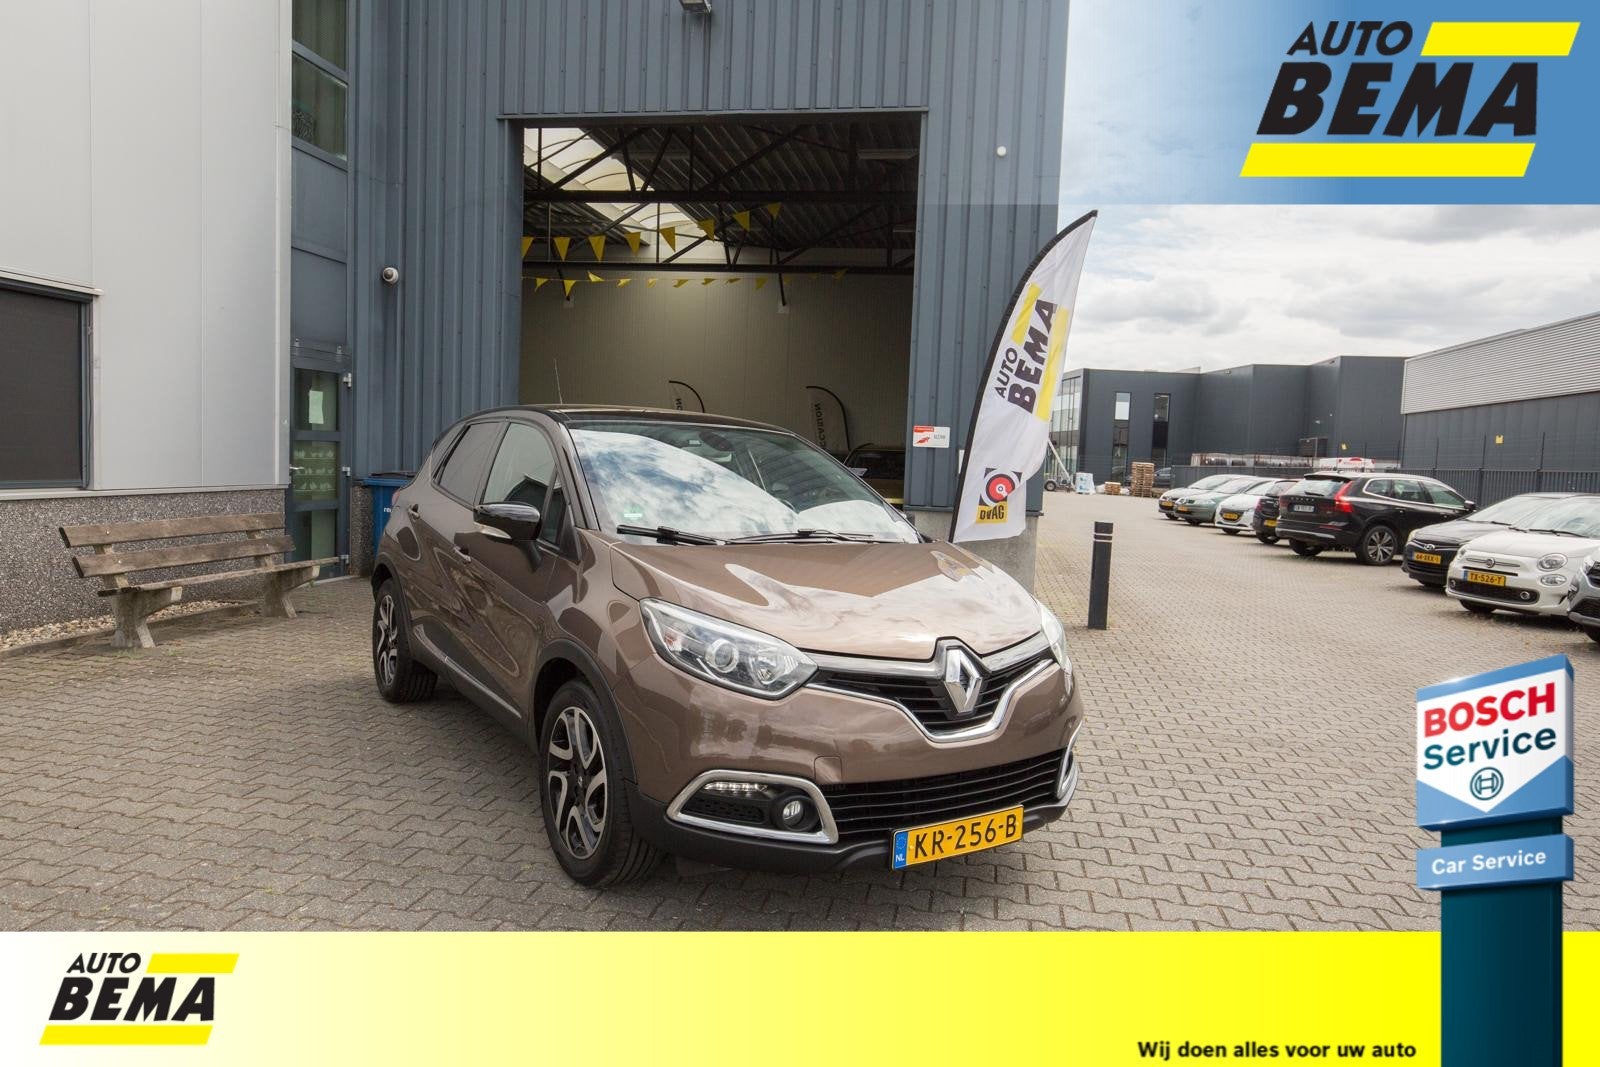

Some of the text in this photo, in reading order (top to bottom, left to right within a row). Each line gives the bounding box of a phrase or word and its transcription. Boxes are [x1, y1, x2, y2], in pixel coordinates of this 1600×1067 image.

[994, 347, 1018, 399] AUTO
[1007, 299, 1056, 414] BEMA
[1470, 572, 1503, 584] TX-526-T
[895, 814, 1017, 862] NL KR-256-B
